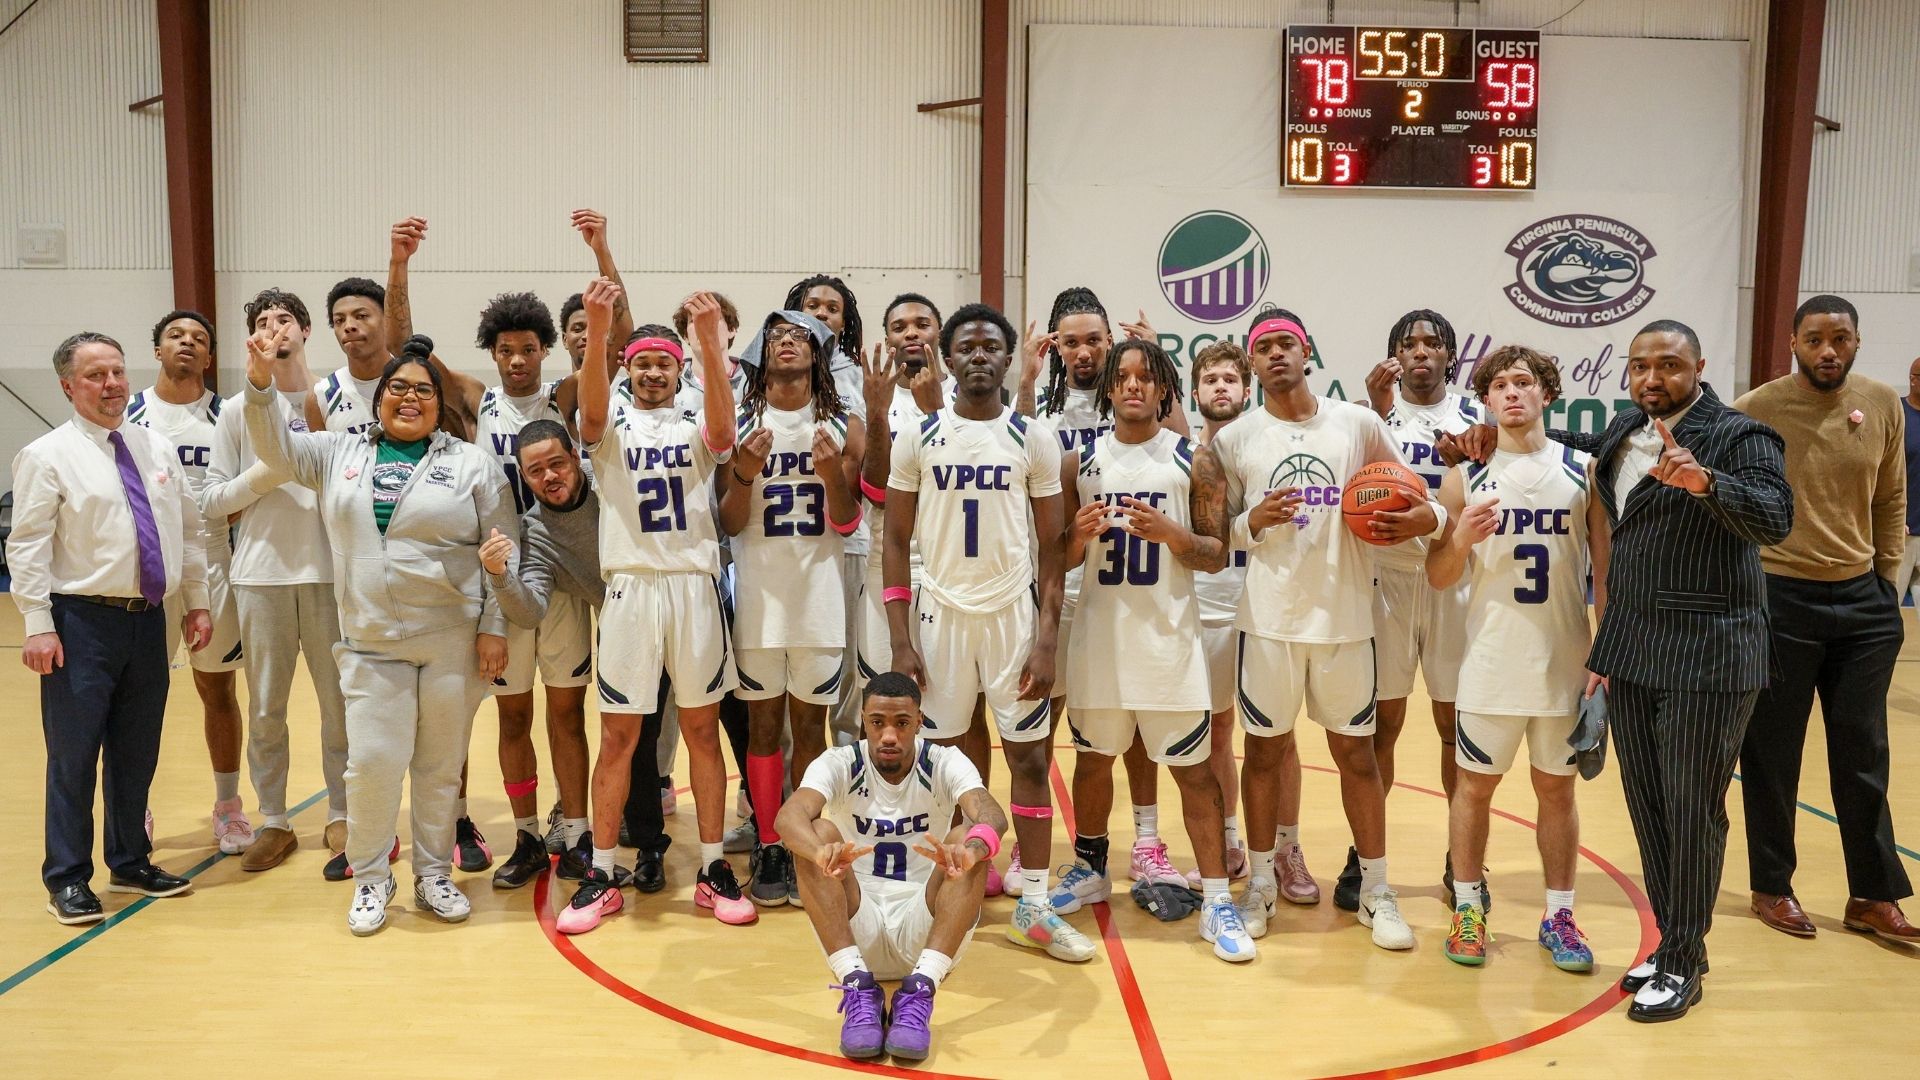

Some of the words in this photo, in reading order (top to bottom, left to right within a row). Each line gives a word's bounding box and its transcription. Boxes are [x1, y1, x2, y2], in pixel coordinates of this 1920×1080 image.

[1290, 37, 1345, 55] HOME
[1477, 41, 1538, 59] GUEST
[1301, 58, 1349, 104] 78
[1487, 62, 1535, 108] 58
[1336, 108, 1372, 119] BONUS
[1404, 89, 1422, 118] 2
[1455, 110, 1490, 121] BONUS
[1288, 123, 1328, 134] FOULS
[1391, 125, 1435, 136] PLAYER
[1498, 127, 1538, 138] FOULS
[1291, 138, 1323, 182] 10
[1327, 142, 1358, 153] T.O.L.
[1468, 144, 1499, 155] T.O.L.
[1334, 154, 1350, 182] 3
[1475, 156, 1491, 185] 3
[1501, 142, 1533, 186] 10
[1512, 218, 1572, 251] VIRGINIA
[1575, 218, 1648, 256] PENINSULA
[1510, 286, 1588, 324] COMMUNITY
[1591, 287, 1650, 323] COLLEGE
[1572, 343, 1613, 397] of
[177, 445, 211, 467] CC
[627, 443, 692, 471] VPCC
[761, 451, 815, 478] VPC
[932, 464, 1012, 491] VPCC
[637, 475, 687, 533] 21
[762, 482, 825, 537] 23
[1264, 486, 1341, 506] PCC
[962, 498, 979, 558] 1
[1494, 508, 1571, 536] VPCC
[1098, 526, 1160, 586] 30
[1513, 543, 1550, 604] 3
[852, 811, 930, 838] VPCC
[872, 841, 908, 882] 0
